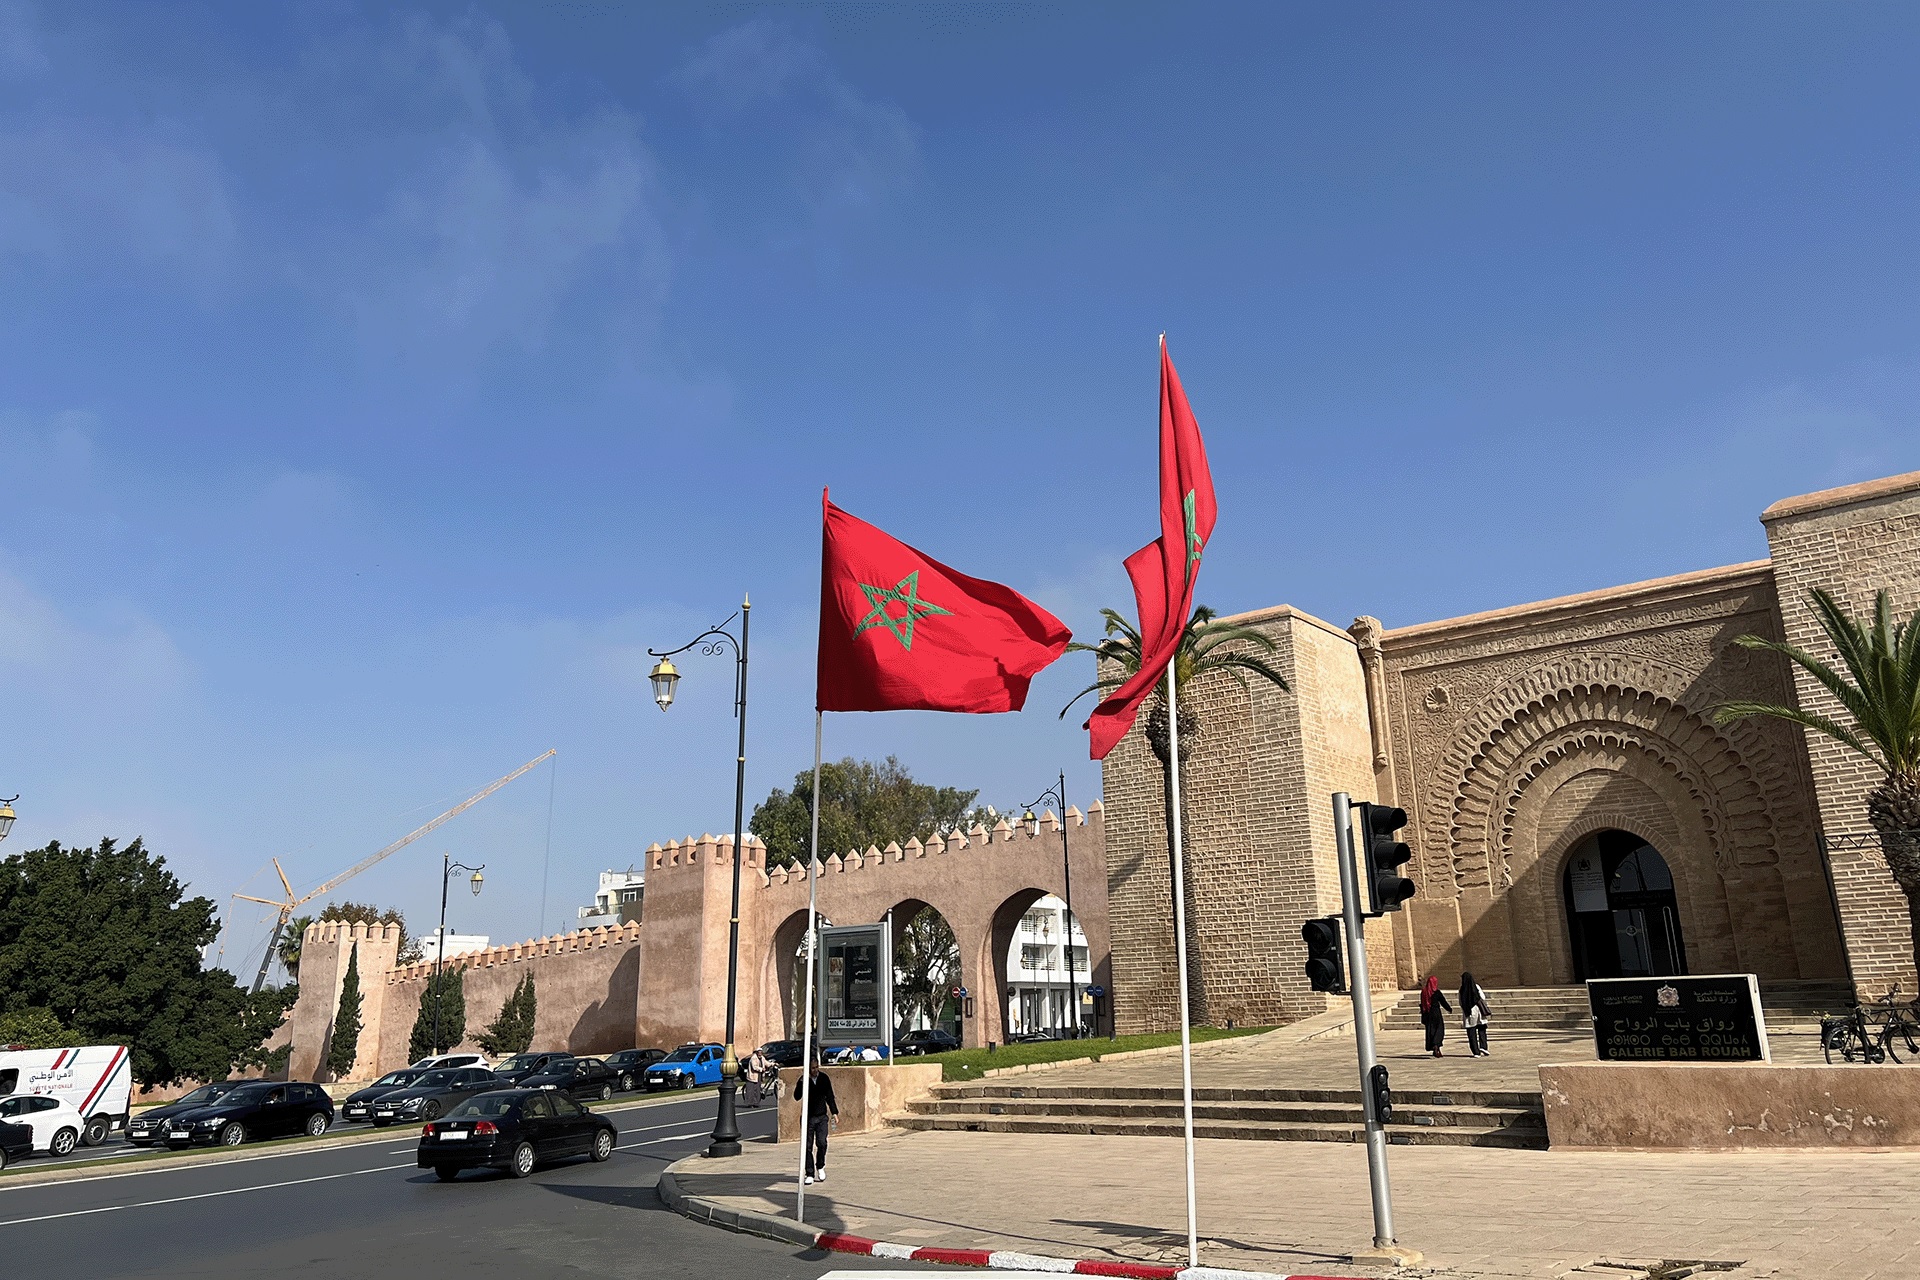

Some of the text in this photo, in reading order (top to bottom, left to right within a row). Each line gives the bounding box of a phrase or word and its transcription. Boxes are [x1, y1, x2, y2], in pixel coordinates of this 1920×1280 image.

[1613, 1016, 1735, 1033] رواق باب الرواح
[1608, 1046, 1751, 1057] GALERIE BAB ROUAH
